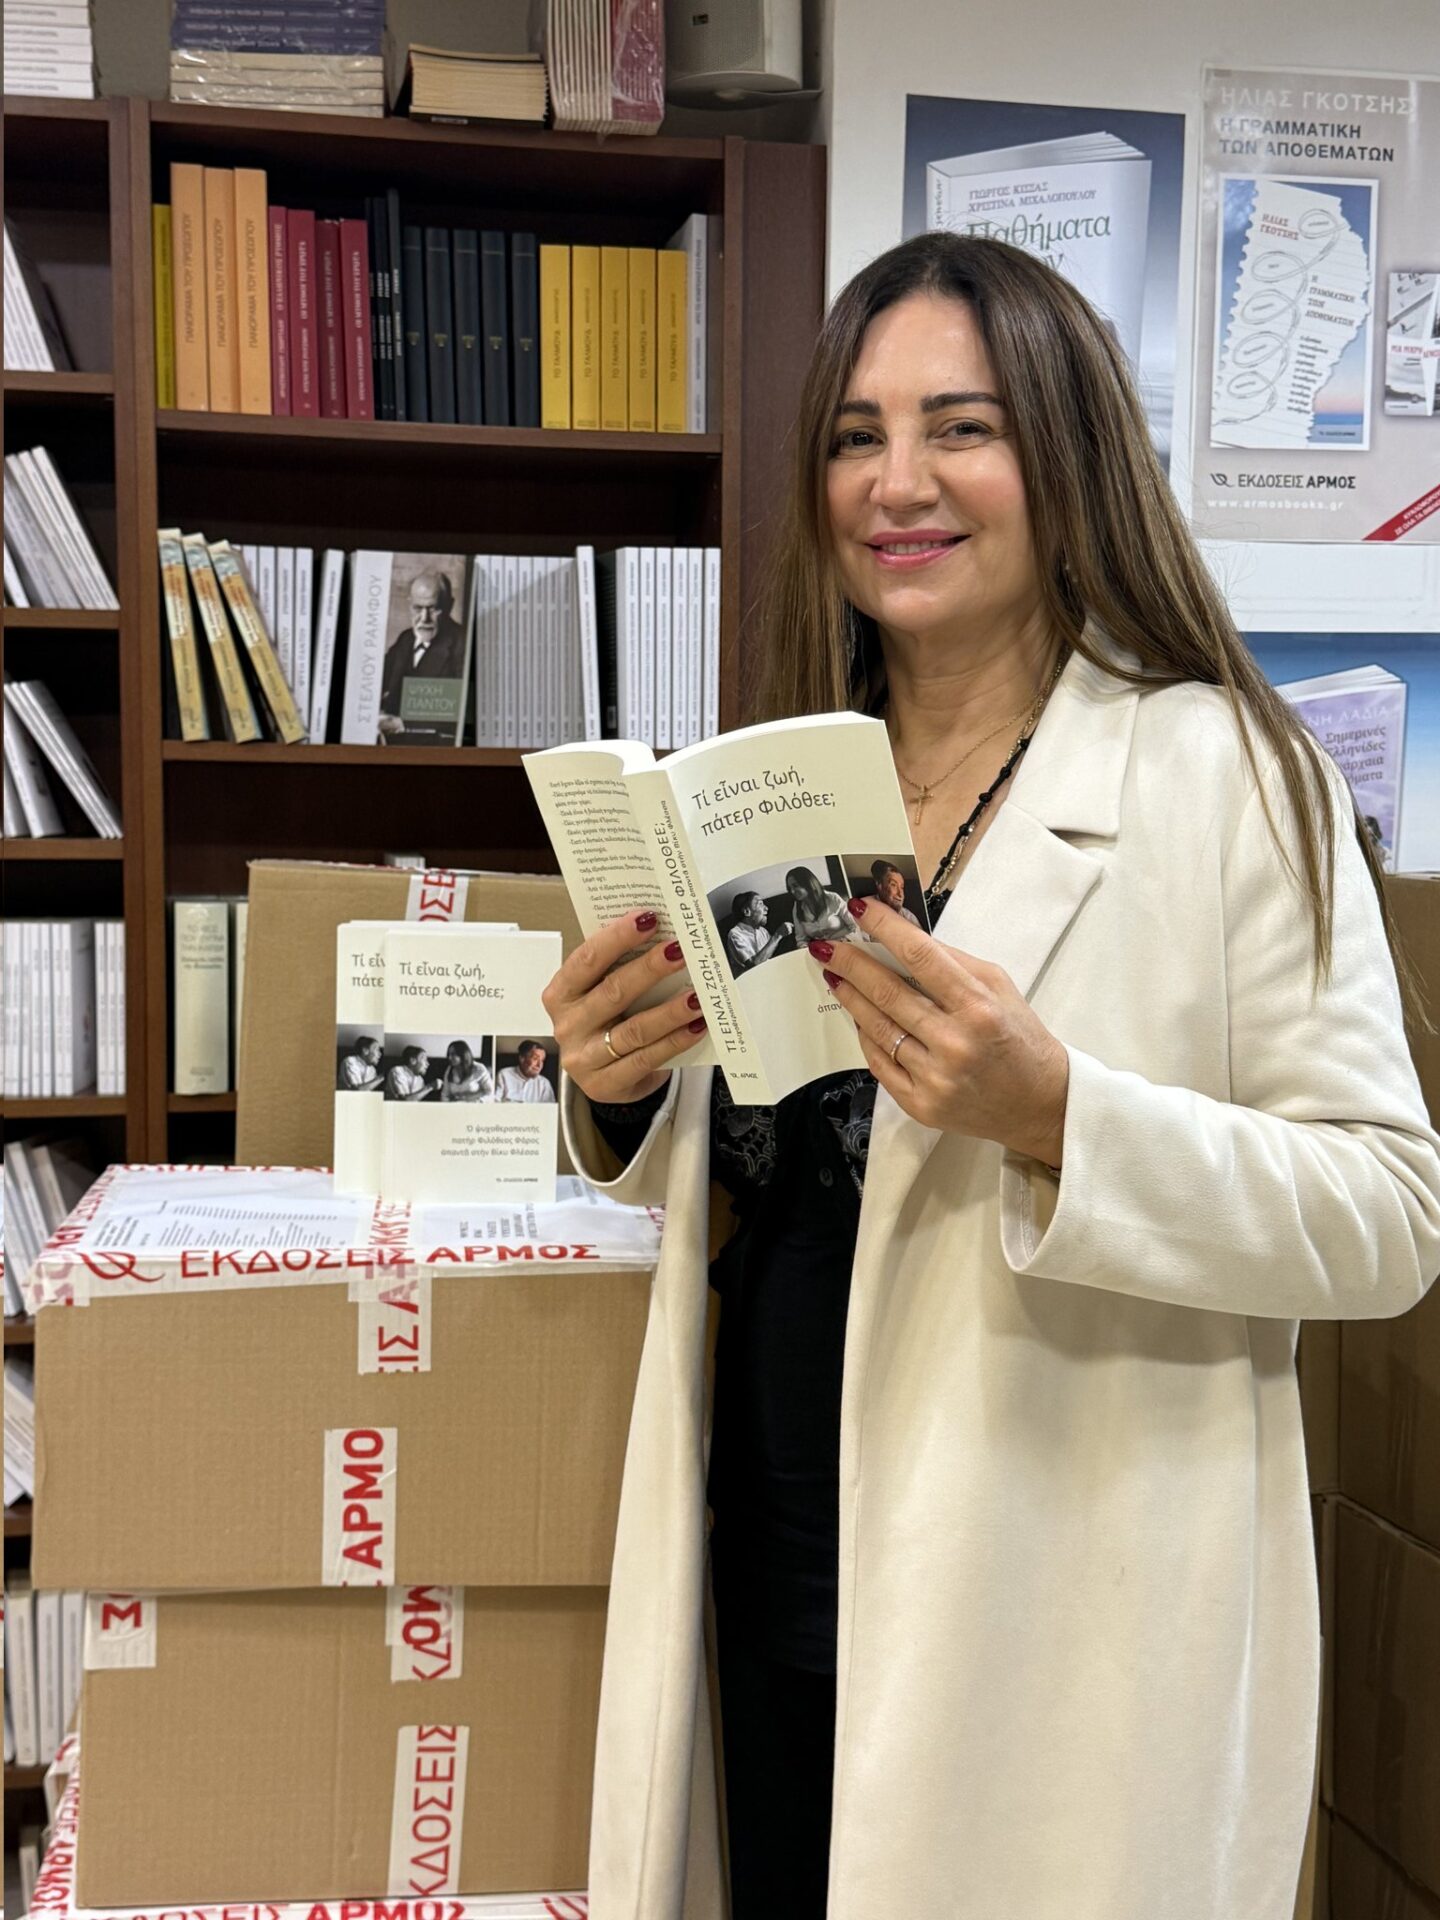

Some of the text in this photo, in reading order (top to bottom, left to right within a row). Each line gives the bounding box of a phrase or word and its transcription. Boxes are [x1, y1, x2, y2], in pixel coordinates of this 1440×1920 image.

[1222, 86, 1411, 116] ΗΛΙΑΣ ΓΚΟΤΣΗΣ
[1240, 119, 1362, 139] ΓΡΑΜΜΑΤΙΚΗ
[1219, 139, 1395, 162] ΤΩΝ ΑΠΟΘΕΜΑΤΩΝ
[1238, 474, 1357, 490] ΕΚΔΟΣΕΙΣ ΑΡΜΟΣ
[357, 574, 382, 723] ΣΤΕΛΙΟΥ ΡΑΜΦΟΥ
[692, 789, 711, 810] Τί
[762, 765, 805, 790] ζωή,
[701, 791, 836, 836] πάτερ Φιλόθεε;
[654, 823, 737, 1053] ΤΙ ΕΙΝΑΙ ΖΩΗ, ΠΑΤΕΡ ΦΙΛΟΘΕΕ;
[351, 953, 386, 968] Τί εἶν
[400, 962, 412, 977] Τί
[454, 962, 486, 980] ζωή,
[351, 973, 384, 988] πάτε
[399, 983, 505, 1000] πάτερ Φιλόθεε;
[181, 1244, 601, 1279] ΕΚΔΟΣΕΙΣ ΑΡΜΟΣ
[343, 1429, 384, 1570] ΑΡΜΟ
